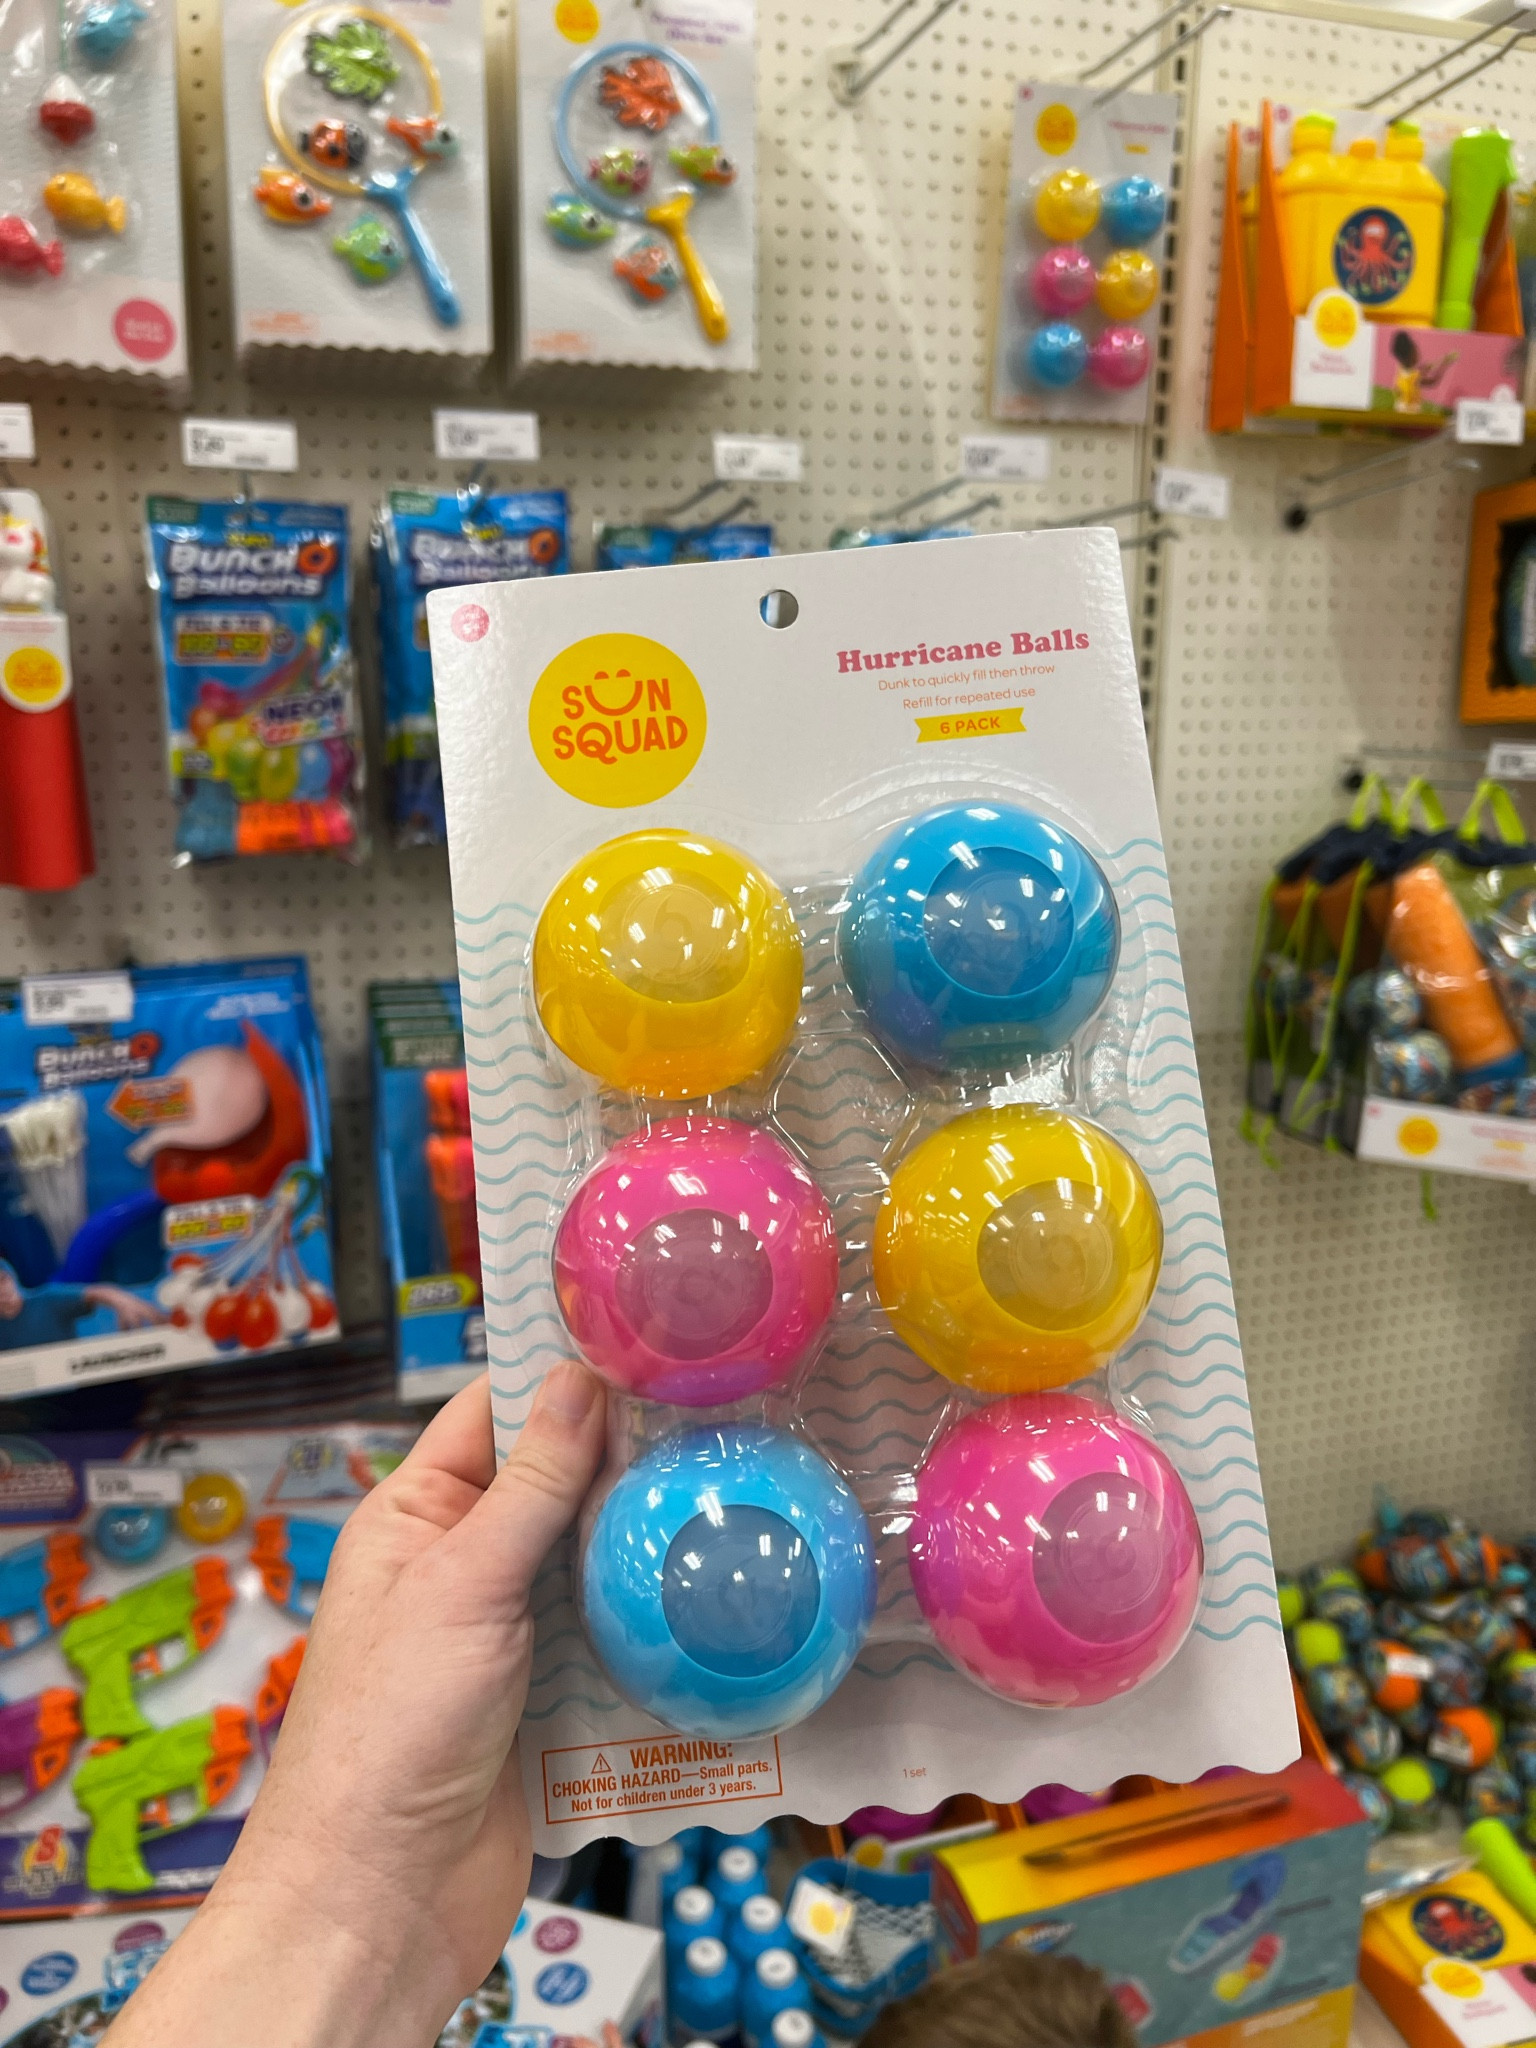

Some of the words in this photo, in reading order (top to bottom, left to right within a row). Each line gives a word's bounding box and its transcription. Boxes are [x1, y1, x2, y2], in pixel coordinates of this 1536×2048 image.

[836, 641, 1002, 673] Hurricane
[1010, 628, 1090, 655] Balls
[878, 679, 910, 691] Dunk
[913, 677, 926, 688] to
[928, 672, 970, 687] quickly
[972, 669, 987, 681] fill
[989, 668, 1017, 679] then
[1020, 664, 1055, 676] throw
[562, 676, 672, 720] SUN
[903, 697, 933, 709] Refill
[935, 695, 951, 706] for
[954, 688, 1010, 705] repeated
[1014, 687, 1036, 699] use
[552, 715, 688, 765] SQUAD
[940, 722, 950, 734] 6
[956, 716, 1000, 733] PACK
[629, 1740, 733, 1769] WARNING:
[552, 1776, 617, 1798] CHOKING
[738, 1760, 772, 1777] parts.
[903, 1768, 908, 1778] 1
[910, 1766, 927, 1777] set
[571, 1798, 592, 1812] Not
[596, 1795, 613, 1809] for
[617, 1790, 666, 1807] children
[670, 1785, 705, 1800] under
[708, 1783, 716, 1795] 3
[720, 1779, 756, 1797] years.
